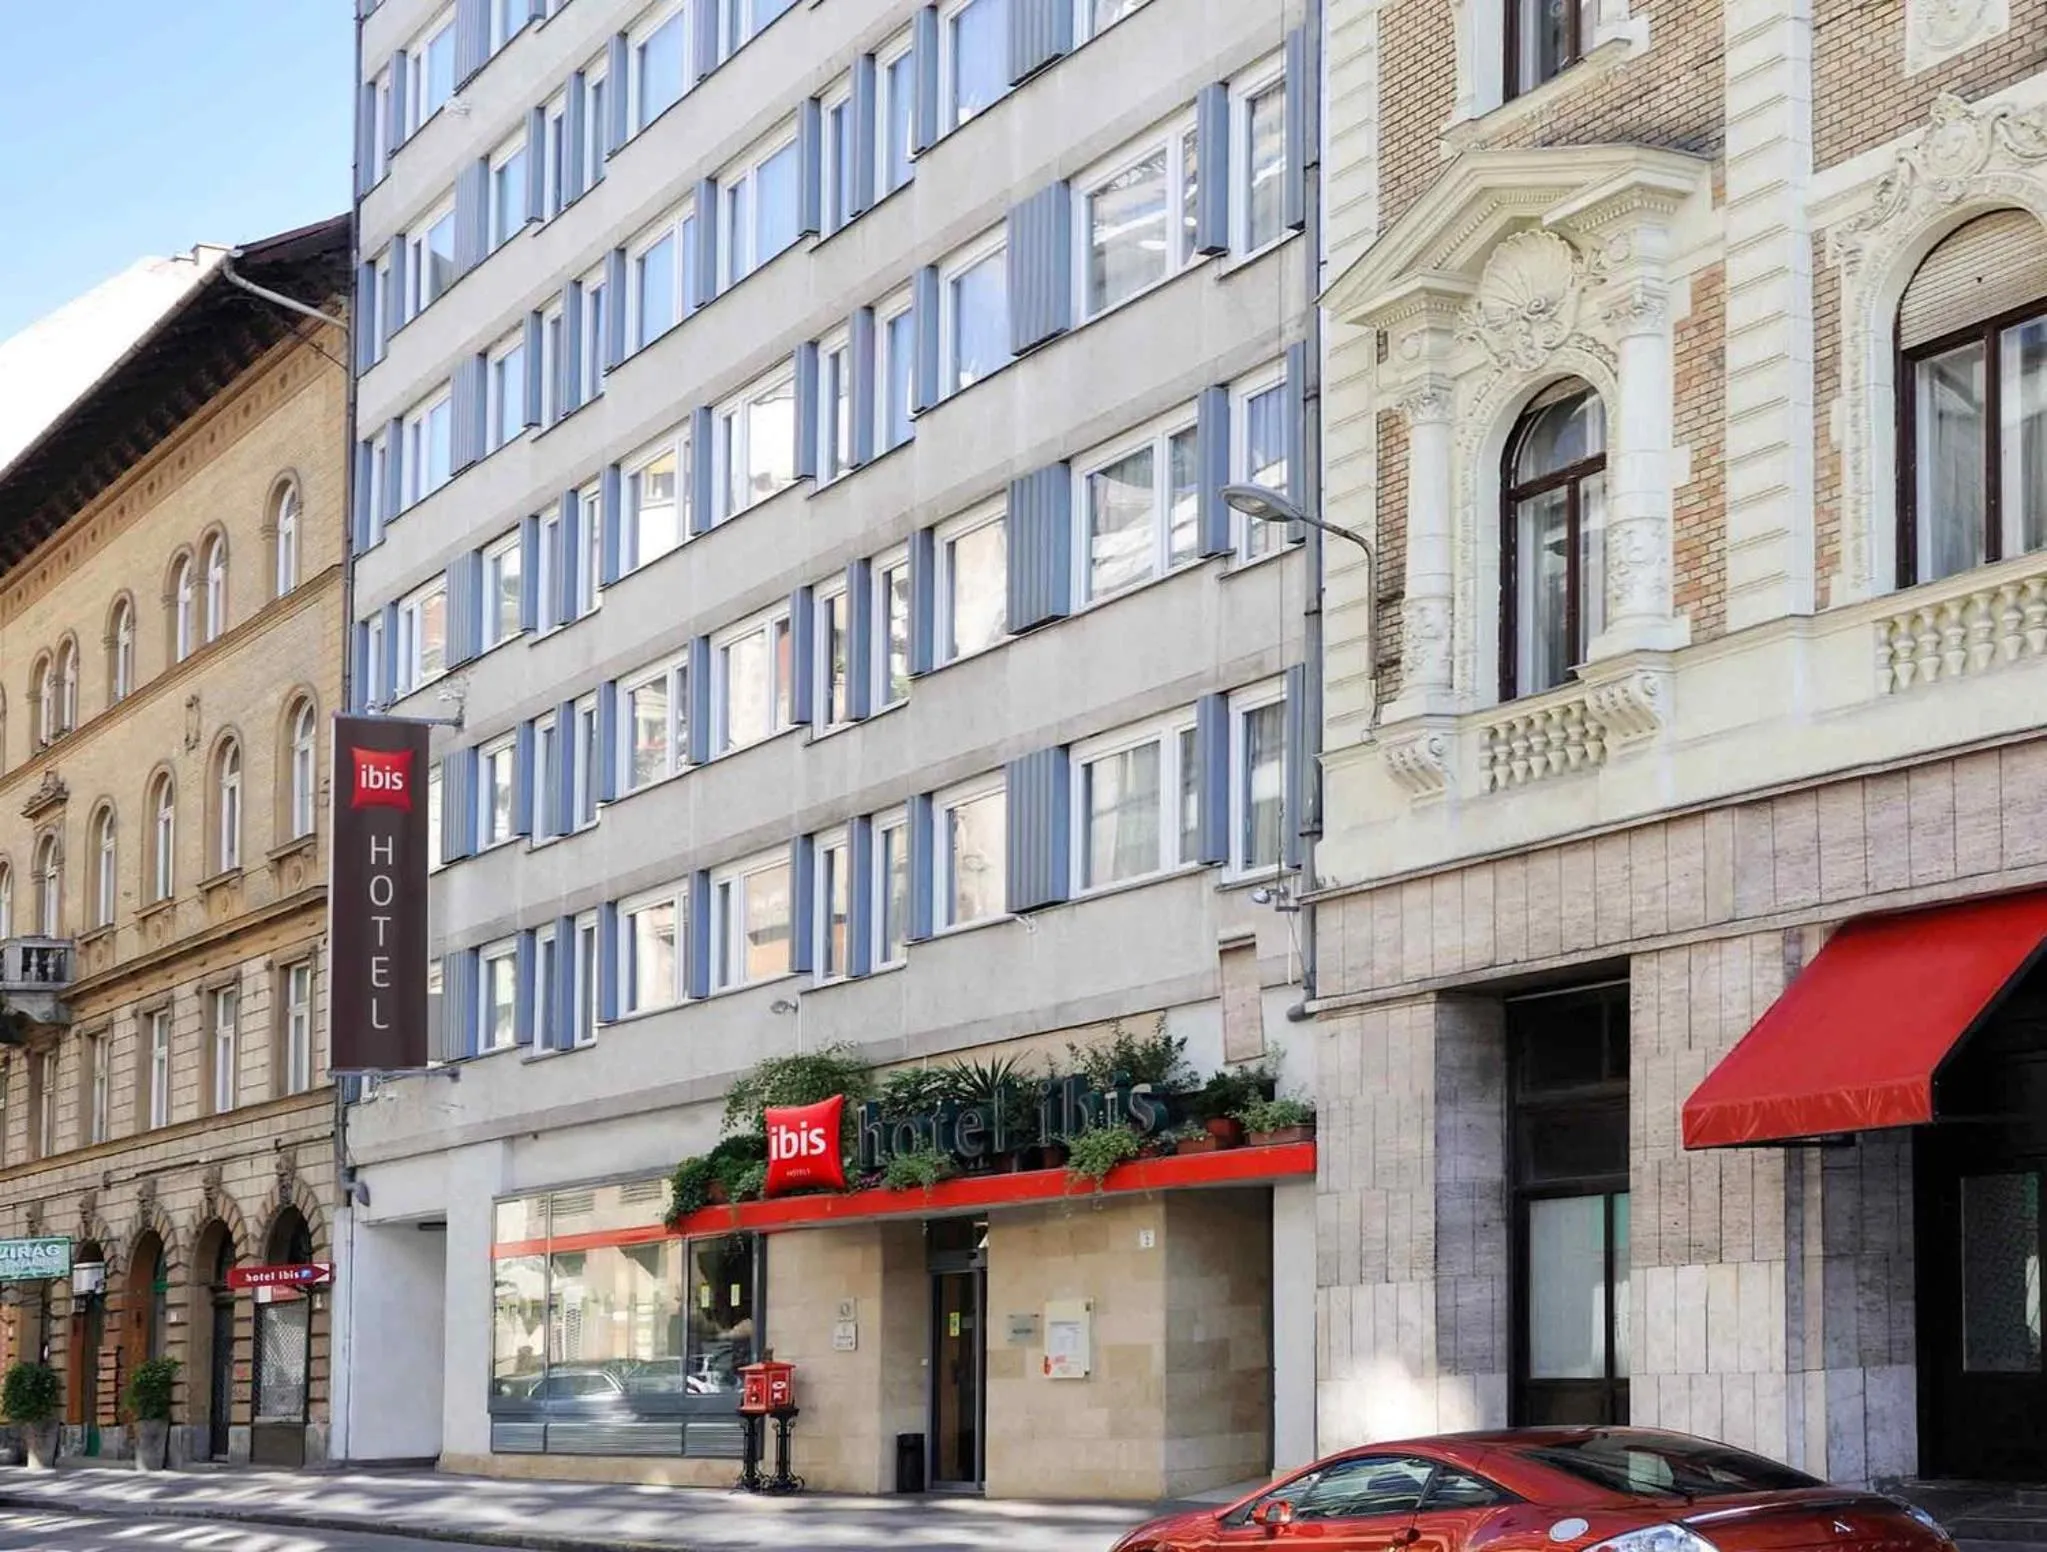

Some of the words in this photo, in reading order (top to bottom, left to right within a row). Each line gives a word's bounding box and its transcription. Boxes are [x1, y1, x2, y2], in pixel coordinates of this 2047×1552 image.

[361, 764, 403, 790] ibis
[369, 835, 394, 1027] HOTEL
[857, 1085, 1006, 1167] hotel
[1037, 1074, 1158, 1150] ibis
[771, 1121, 826, 1160] ibis
[245, 1270, 275, 1282] hotel
[279, 1269, 299, 1280] ibis
